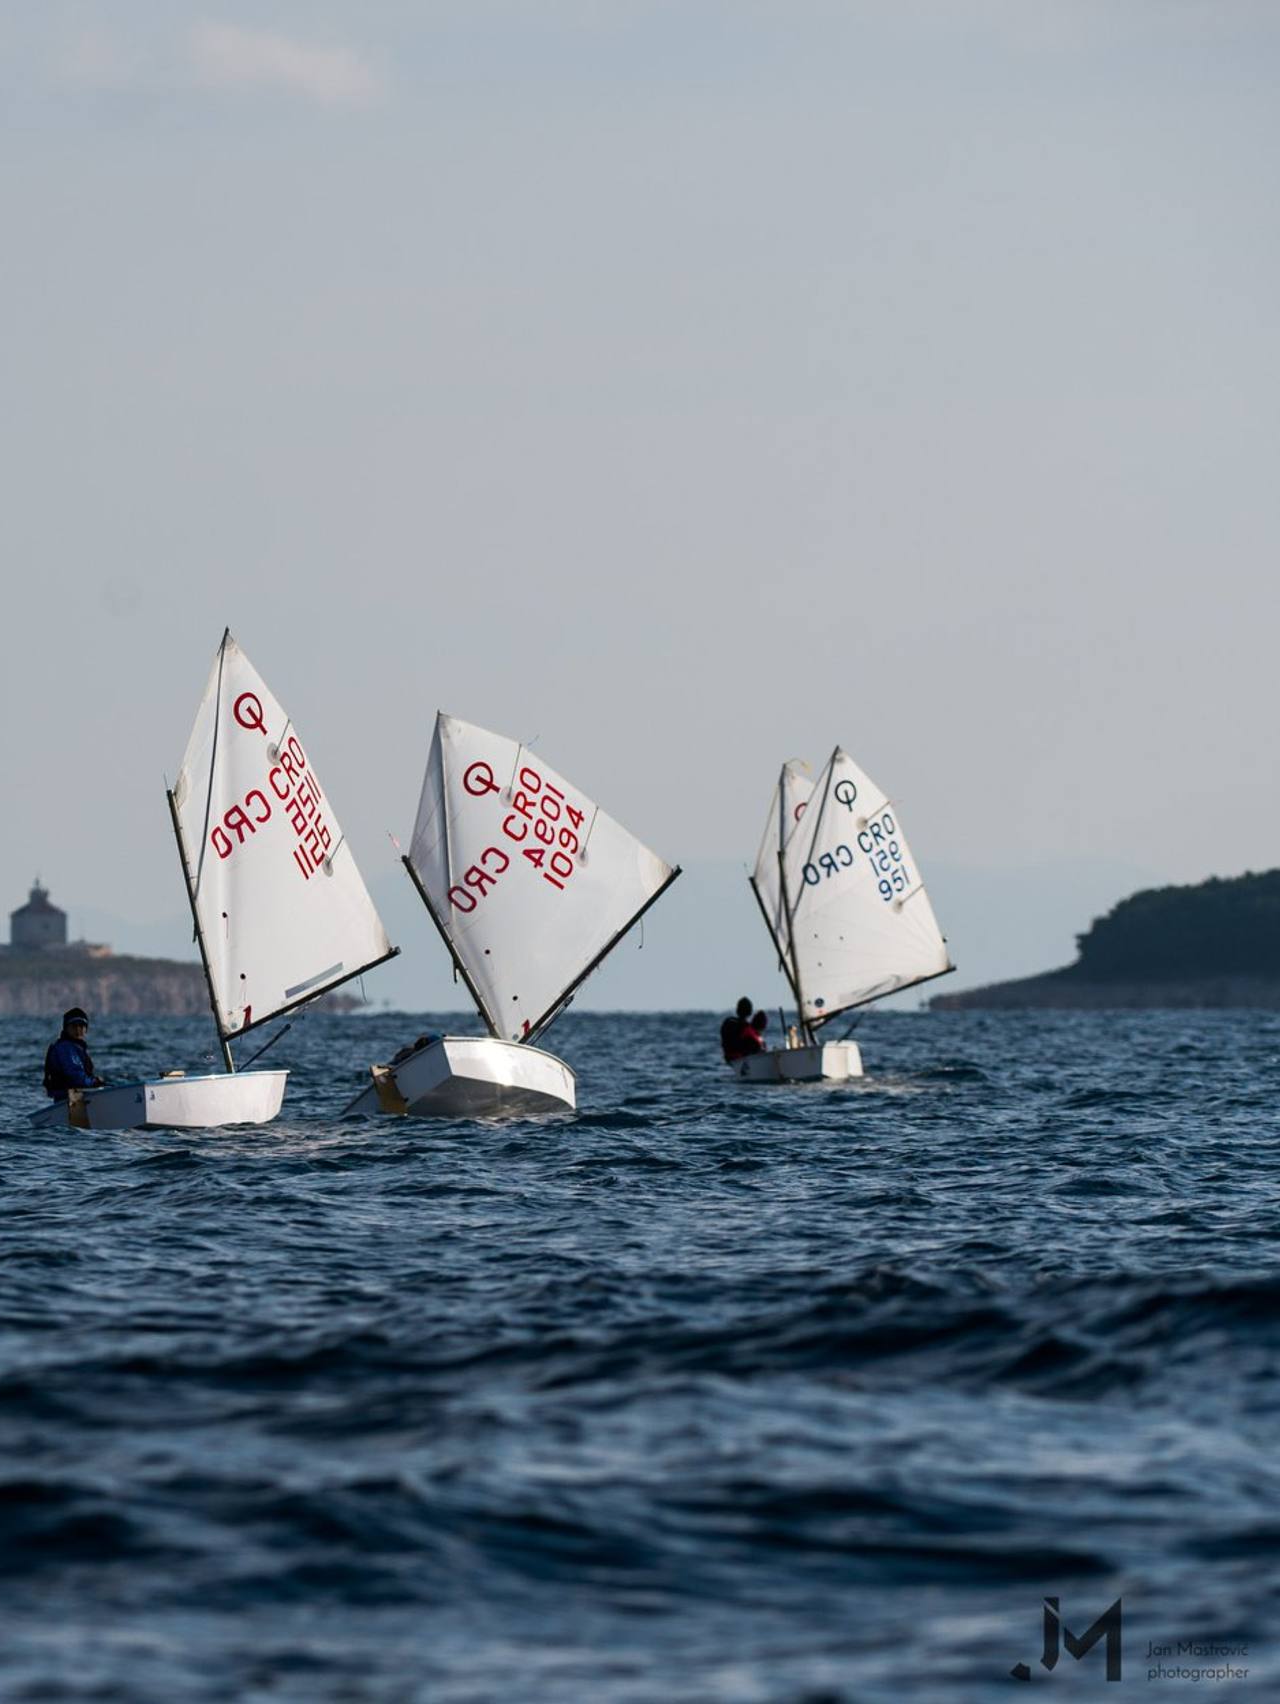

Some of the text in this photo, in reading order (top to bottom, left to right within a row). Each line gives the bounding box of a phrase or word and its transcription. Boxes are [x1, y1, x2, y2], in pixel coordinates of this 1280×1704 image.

[269, 736, 305, 800] CRO
[503, 767, 541, 841] CRO
[857, 813, 895, 853] CRO
[293, 813, 331, 881] 1126
[543, 804, 585, 890] 1094
[879, 864, 910, 901] 951
